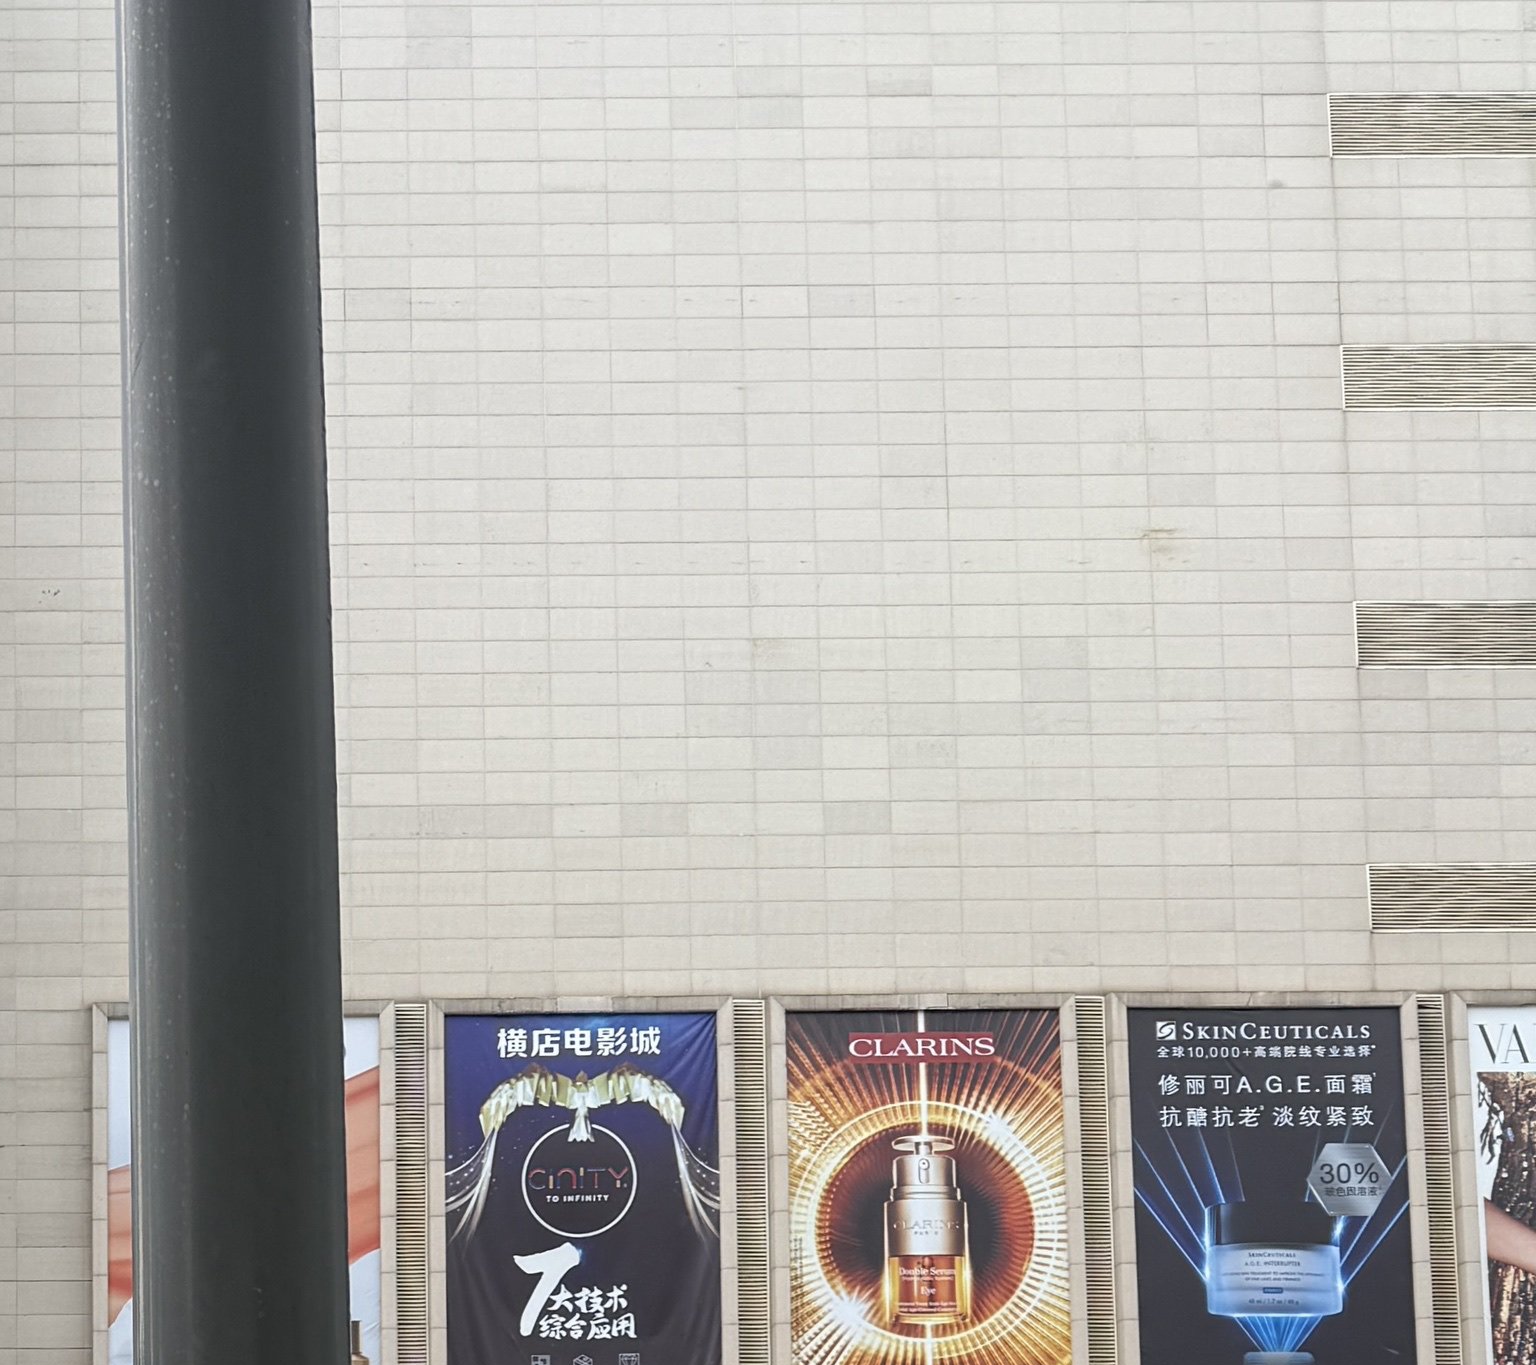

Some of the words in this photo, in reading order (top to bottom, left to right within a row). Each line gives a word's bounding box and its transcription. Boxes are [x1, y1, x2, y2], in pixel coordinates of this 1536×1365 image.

[497, 1027, 661, 1058] 横店电影城
[849, 1036, 995, 1060] CLARINS
[1473, 1024, 1536, 1064] VA
[1273, 1105, 1375, 1127] 淡纹紧致
[1320, 1163, 1379, 1184] 30%
[546, 1195, 559, 1203] TO
[563, 1194, 609, 1202] INFINITY
[539, 1313, 637, 1340] 综合应用
